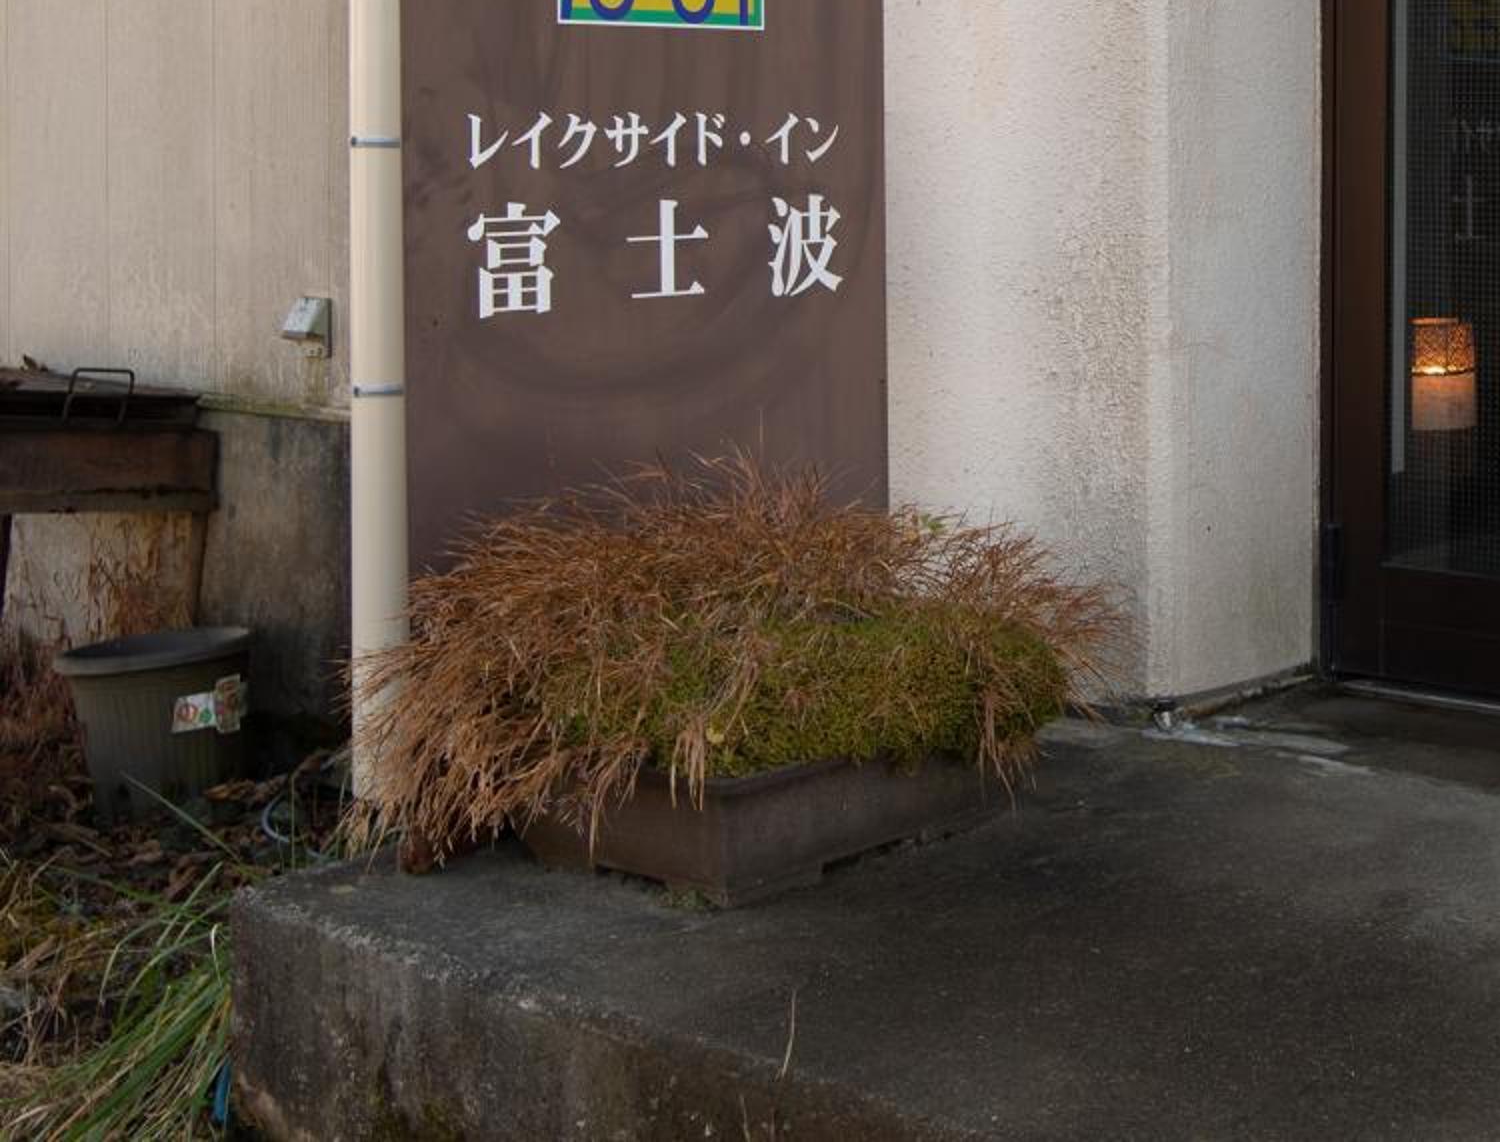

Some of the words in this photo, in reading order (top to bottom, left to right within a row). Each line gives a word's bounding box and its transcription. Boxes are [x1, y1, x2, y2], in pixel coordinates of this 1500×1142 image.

[468, 112, 838, 168] レイクサイド・イン
[467, 193, 842, 318] 富士波
